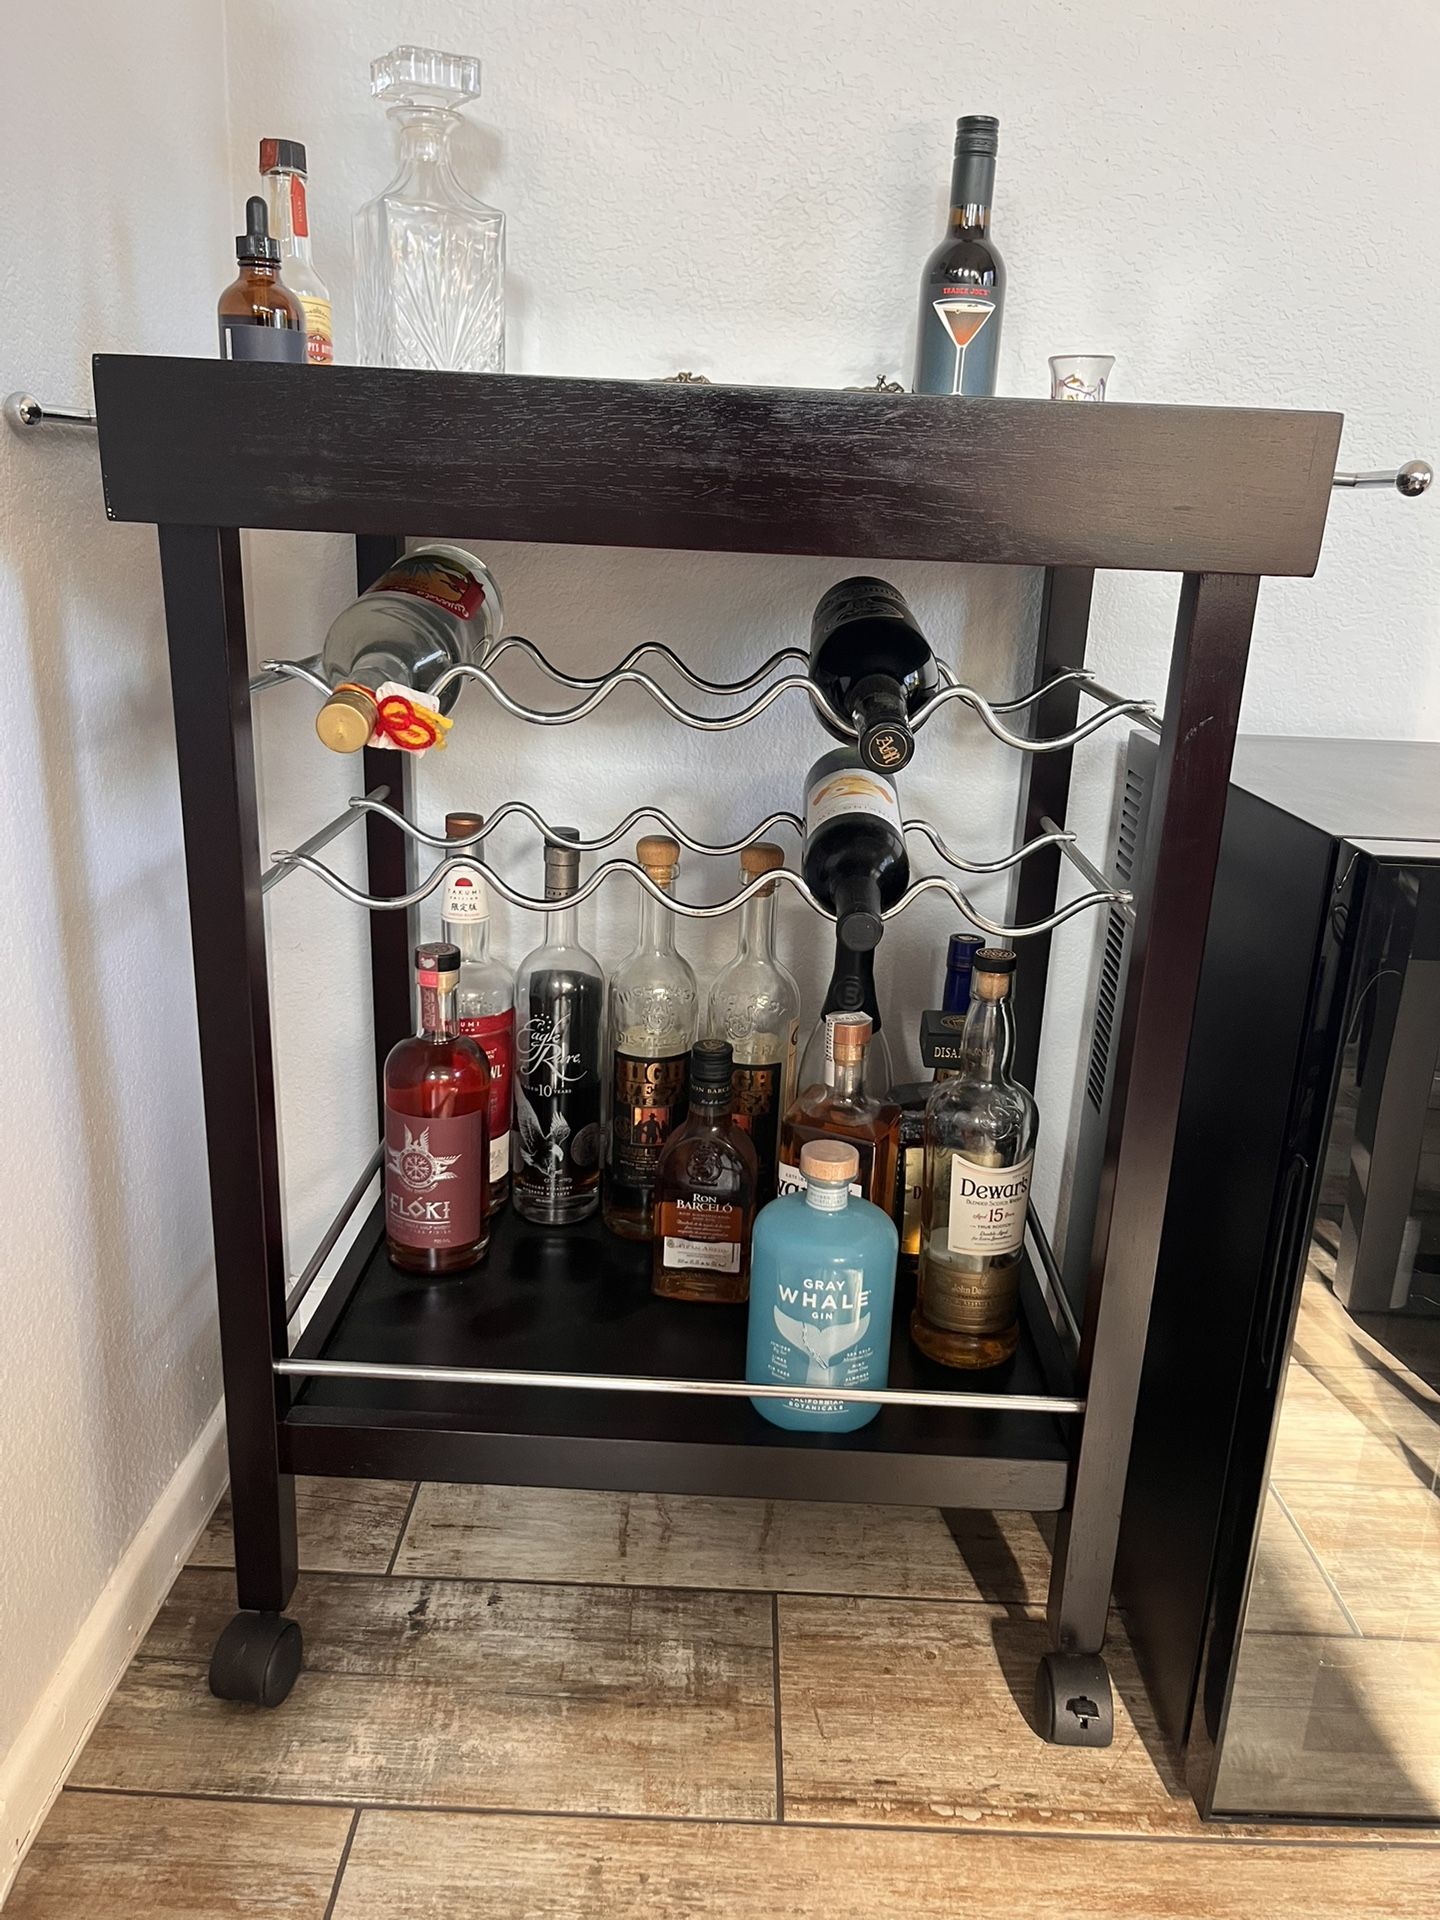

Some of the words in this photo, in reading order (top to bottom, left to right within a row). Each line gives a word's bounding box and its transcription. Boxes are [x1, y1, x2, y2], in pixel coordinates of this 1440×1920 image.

[447, 888, 480, 896] TAKUMI
[516, 1013, 571, 1062] Eagle
[538, 1085, 553, 1097] 10
[960, 1176, 1028, 1200] Dewar's
[693, 1193, 717, 1203] RON
[390, 1193, 450, 1219] FLÓKI
[676, 1199, 733, 1213] BARCELÓ
[988, 1208, 1004, 1223] 15
[803, 1278, 845, 1291] GRAY
[779, 1284, 869, 1310] WHALE
[811, 1312, 833, 1320] GIN
[789, 1400, 843, 1411] BOTANICALS
